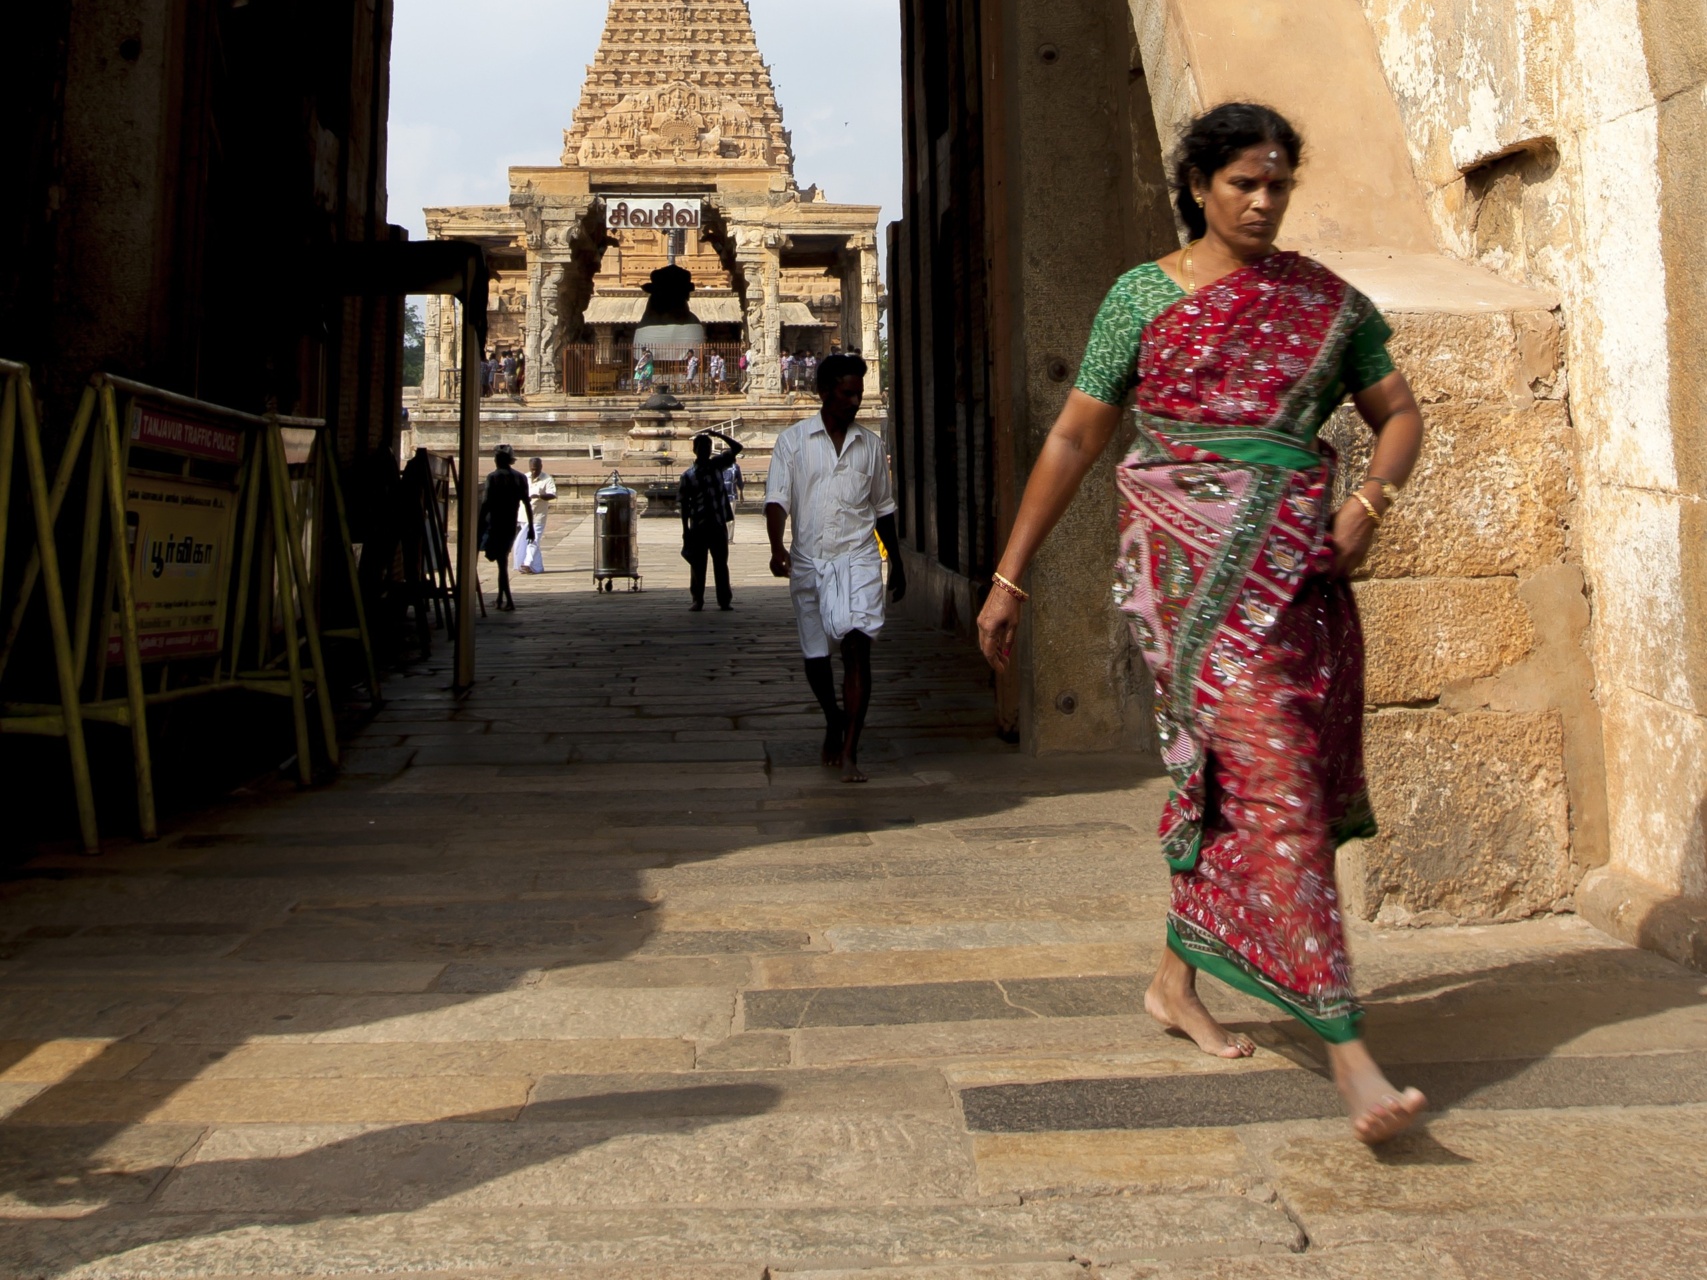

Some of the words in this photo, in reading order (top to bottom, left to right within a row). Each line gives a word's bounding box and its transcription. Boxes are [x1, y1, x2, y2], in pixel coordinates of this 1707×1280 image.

[143, 415, 183, 442] TANJAVUR
[184, 424, 212, 448] TRAFFIC
[212, 431, 236, 453] POLICE
[151, 533, 213, 578] பூர்விகா
